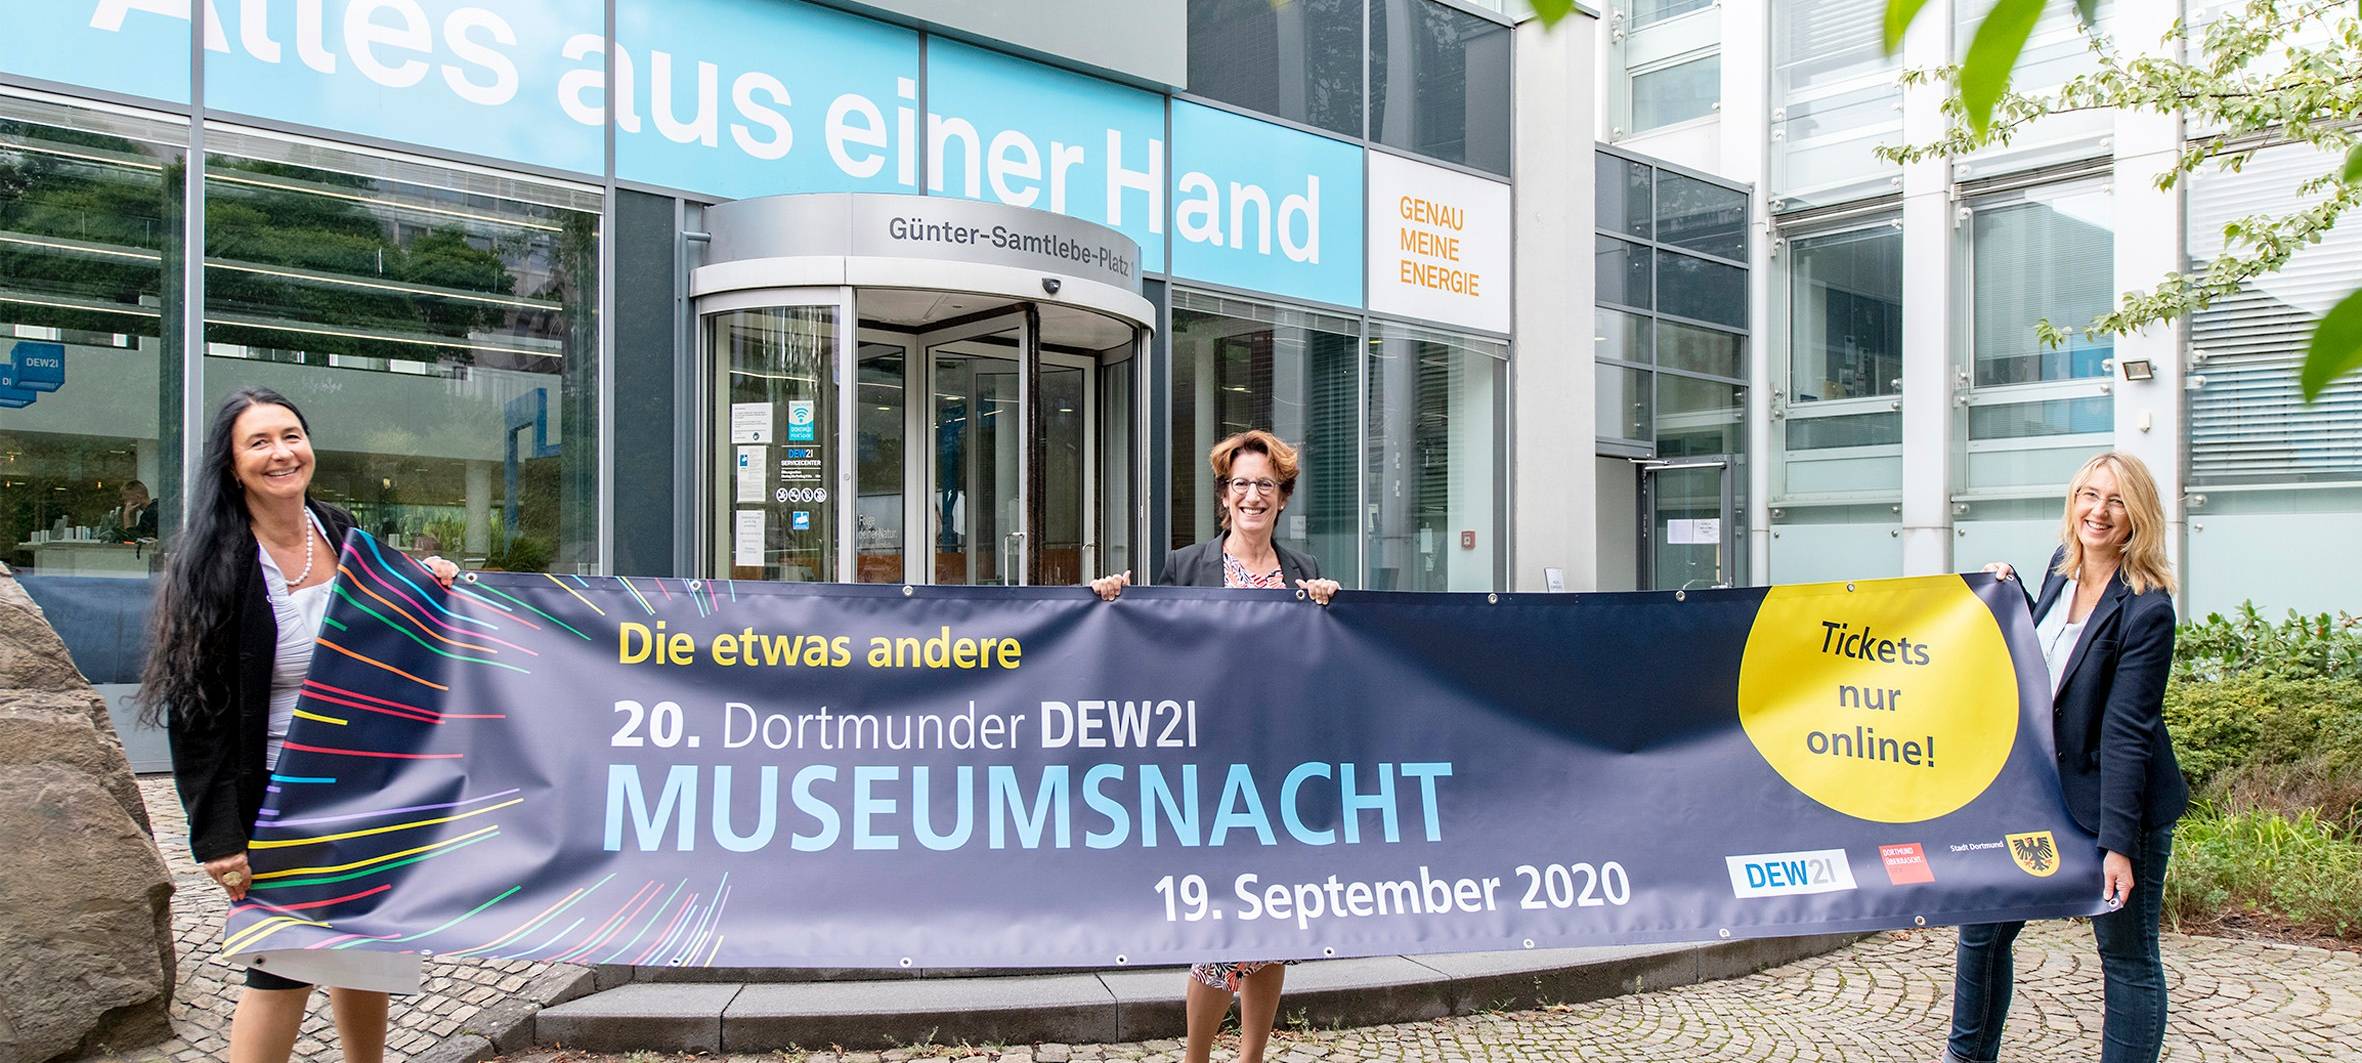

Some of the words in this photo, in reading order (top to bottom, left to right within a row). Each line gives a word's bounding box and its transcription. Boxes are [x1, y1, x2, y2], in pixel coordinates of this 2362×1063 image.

[89, 0, 519, 106] les
[557, 33, 794, 160] aus
[824, 76, 1084, 214] einer
[1106, 128, 1320, 265] Hand
[1400, 195, 1464, 231] GENAU
[889, 216, 1129, 277] Günter-Samtlebe-Platz
[1400, 227, 1460, 262] MEINE
[1400, 259, 1480, 296] ENERGIE
[618, 620, 695, 666] Die
[711, 625, 851, 669] etwas
[867, 625, 1023, 670] andere
[1821, 620, 1931, 666] Tickets
[1838, 683, 1901, 712] nur
[610, 700, 700, 748] 20.
[723, 700, 1026, 750] Dortmunder
[1806, 725, 1935, 768] online!
[602, 761, 1453, 853] MUSEUMSNACHT
[1950, 843, 1968, 852] Stadt
[1970, 840, 2004, 851] Dortmund
[1154, 873, 1222, 923] 19.
[1237, 866, 1501, 930] September
[1514, 861, 1632, 911] 2020
